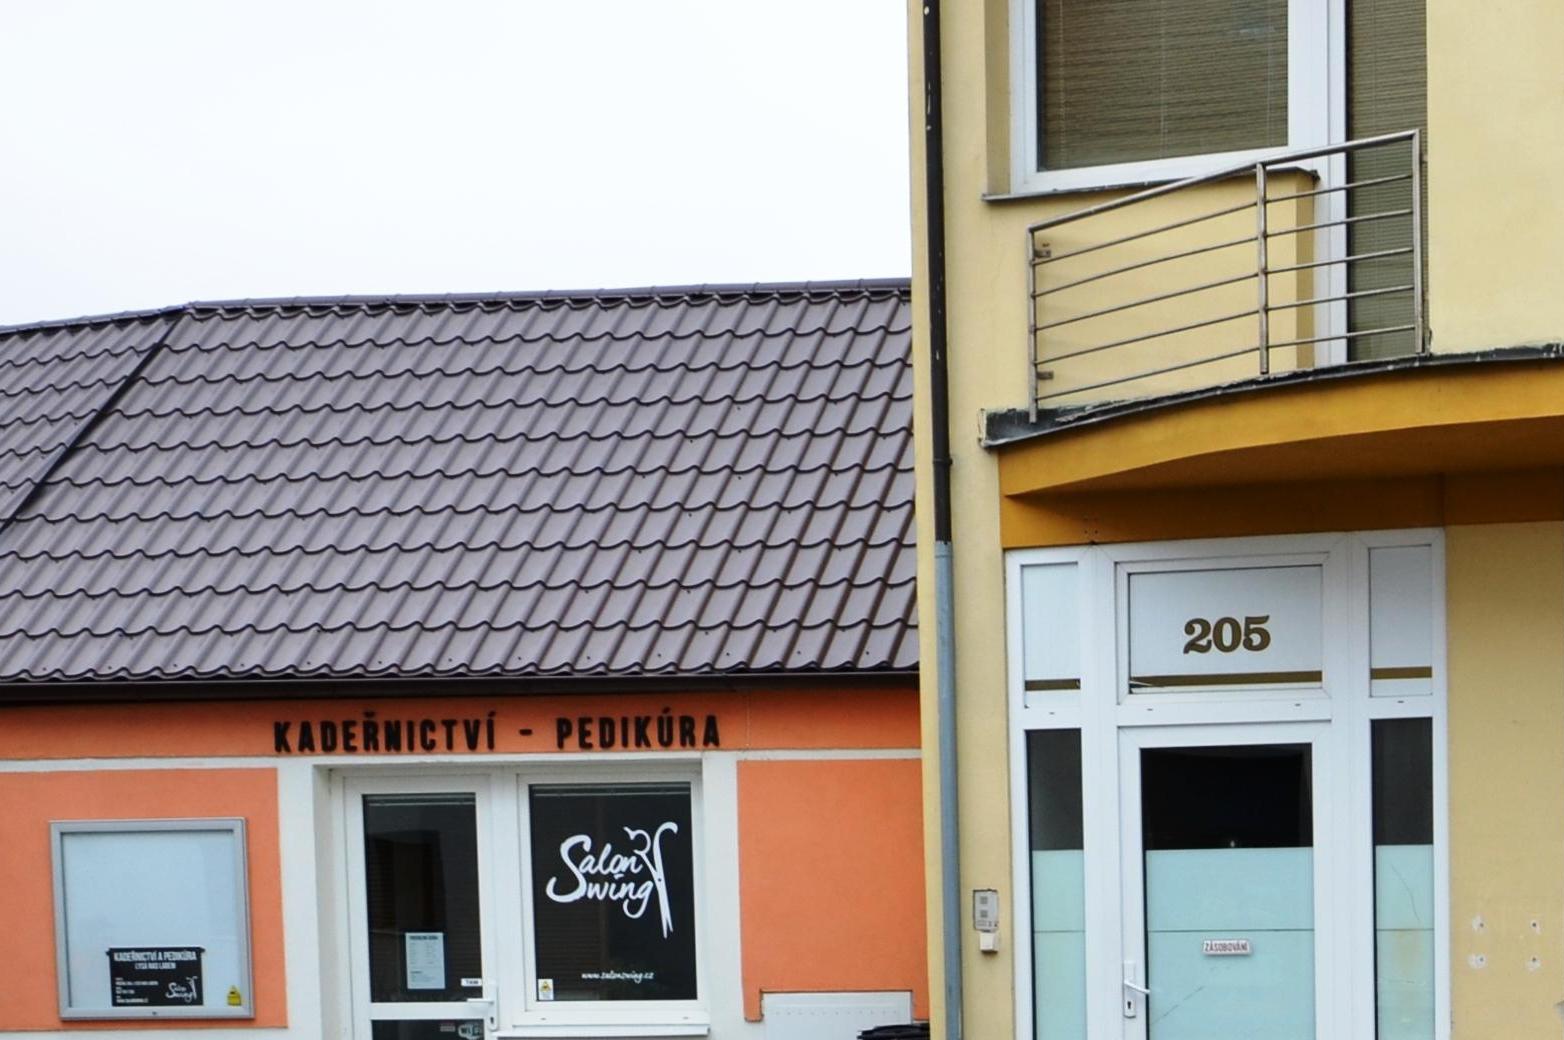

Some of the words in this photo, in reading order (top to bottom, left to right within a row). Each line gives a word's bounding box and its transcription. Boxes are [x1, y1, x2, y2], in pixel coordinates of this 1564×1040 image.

[1183, 614, 1271, 654] 205
[273, 711, 496, 753] KADEŘNICTVÍ
[556, 707, 721, 750] PEDIKÚRA
[547, 834, 643, 890] Salon
[113, 950, 157, 961] KADEŘNICTVÍ
[165, 950, 197, 961] PEDIKÚRA
